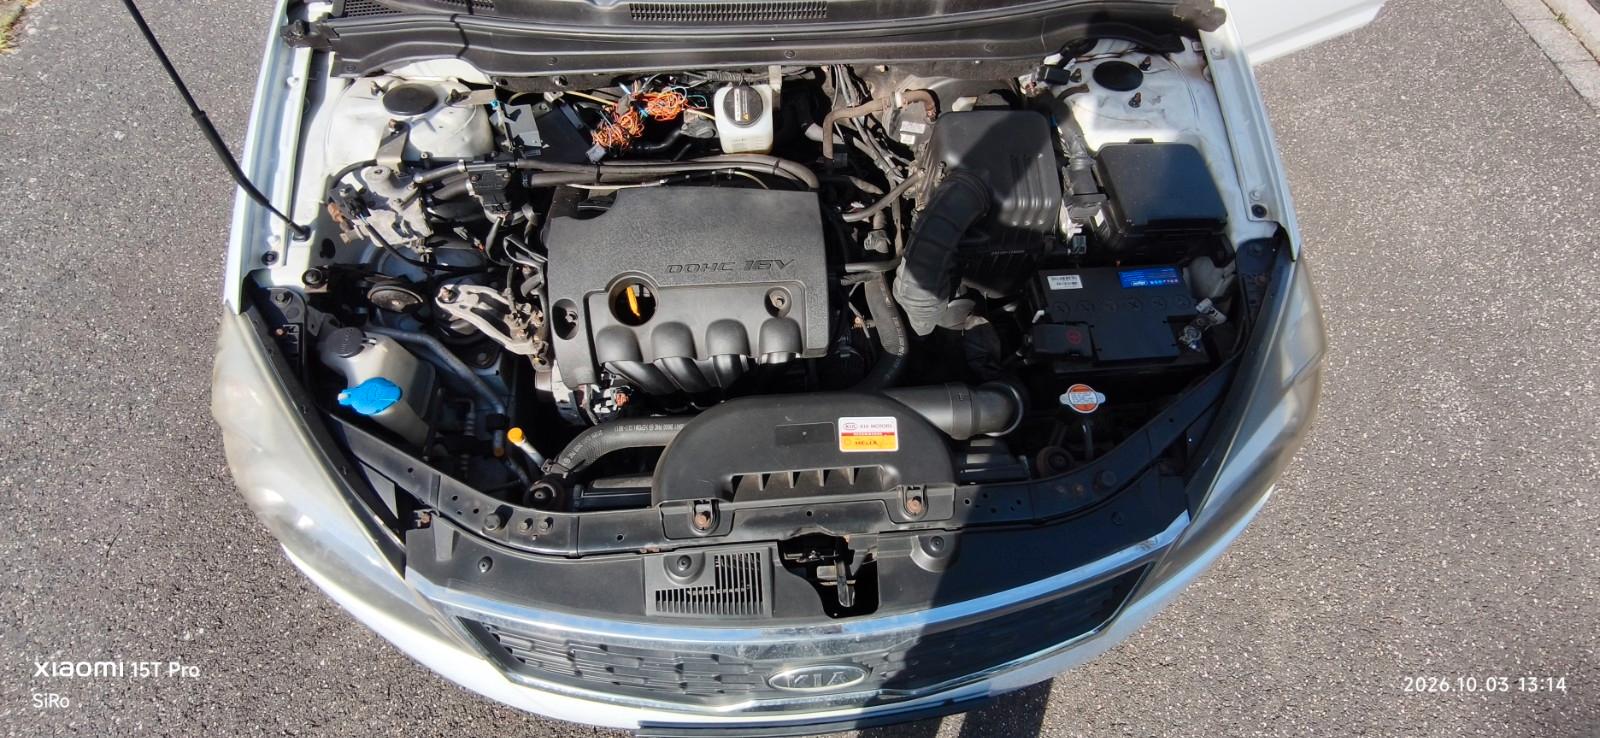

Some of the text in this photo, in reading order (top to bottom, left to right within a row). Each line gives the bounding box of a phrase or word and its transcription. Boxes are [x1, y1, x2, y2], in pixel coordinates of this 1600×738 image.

[664, 259, 795, 274] DOHC 16V
[786, 671, 851, 689] KIA
